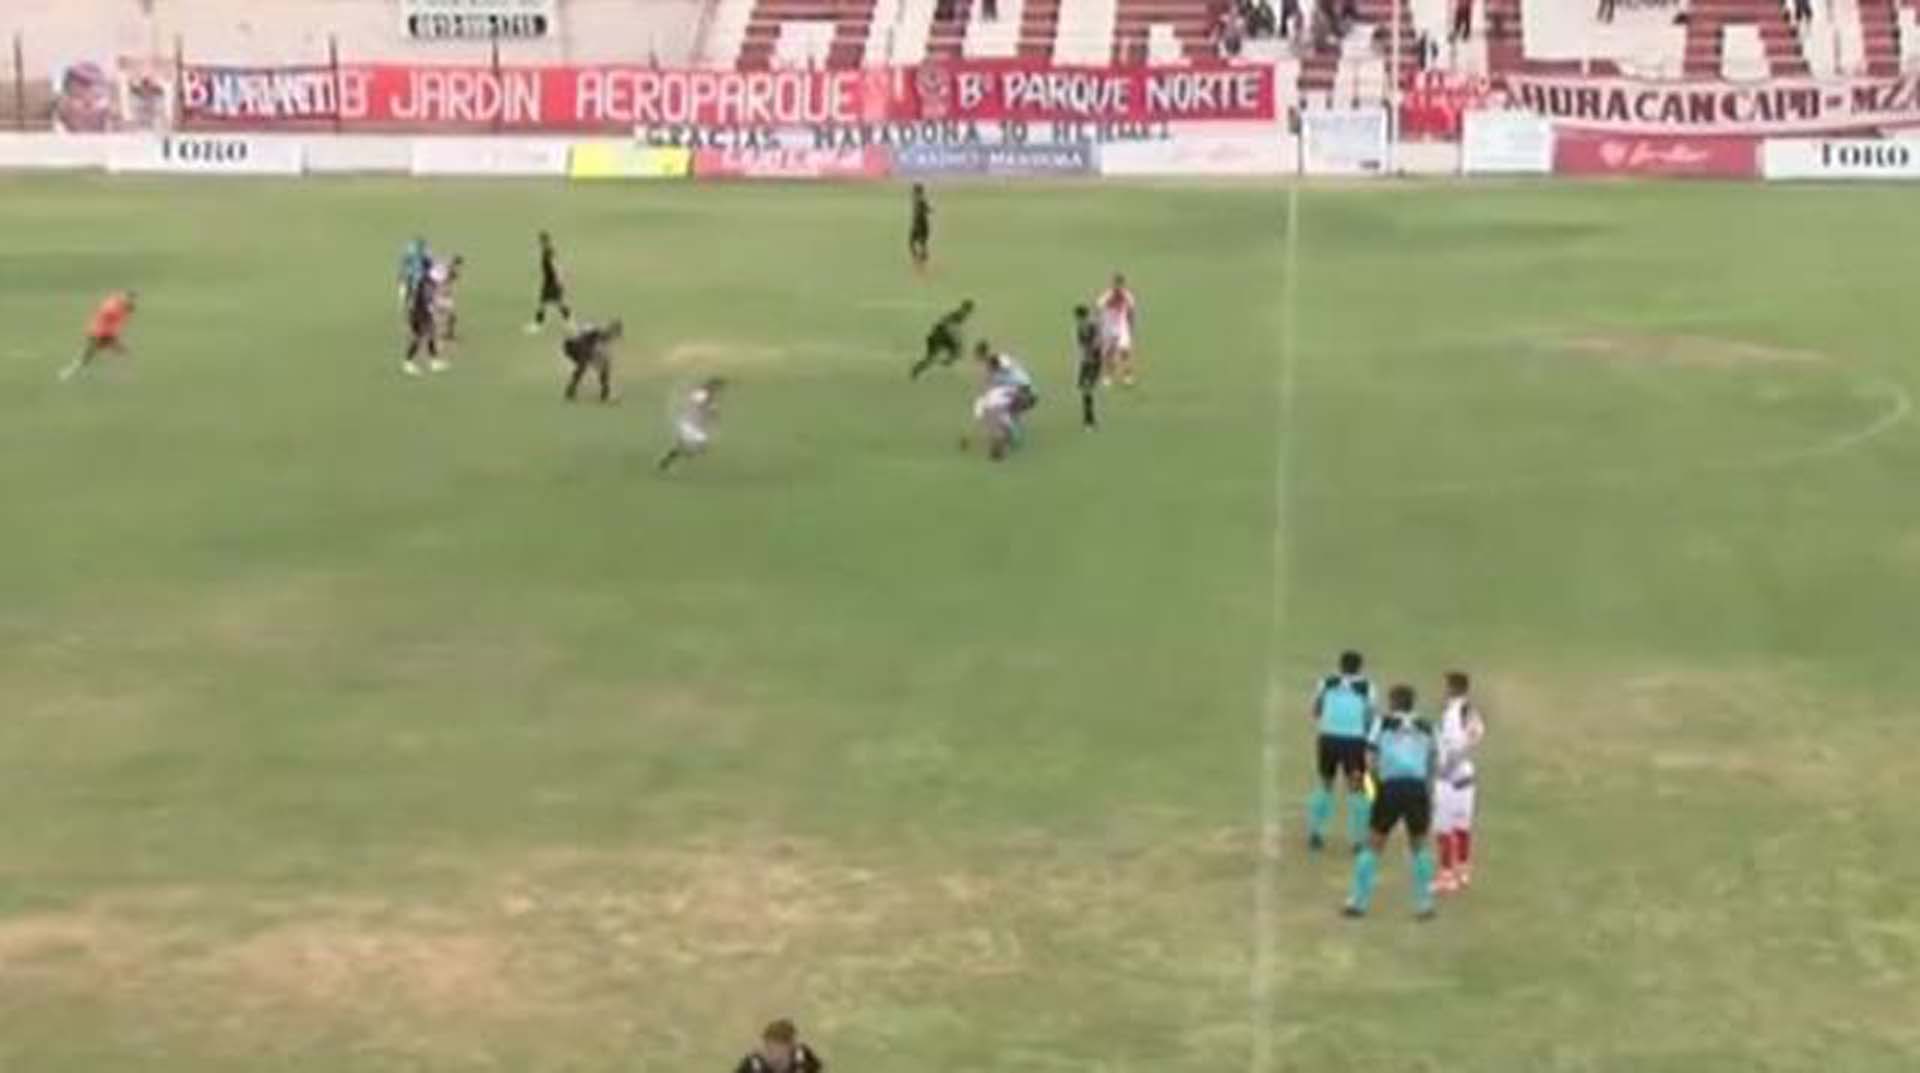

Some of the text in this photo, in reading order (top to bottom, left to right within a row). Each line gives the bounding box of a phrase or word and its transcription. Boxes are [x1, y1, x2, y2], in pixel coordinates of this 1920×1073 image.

[391, 71, 541, 122] JARDIN
[575, 71, 861, 125] AEROPARQUE
[1002, 71, 1131, 114] PARQUE
[1145, 71, 1262, 109] NORTE
